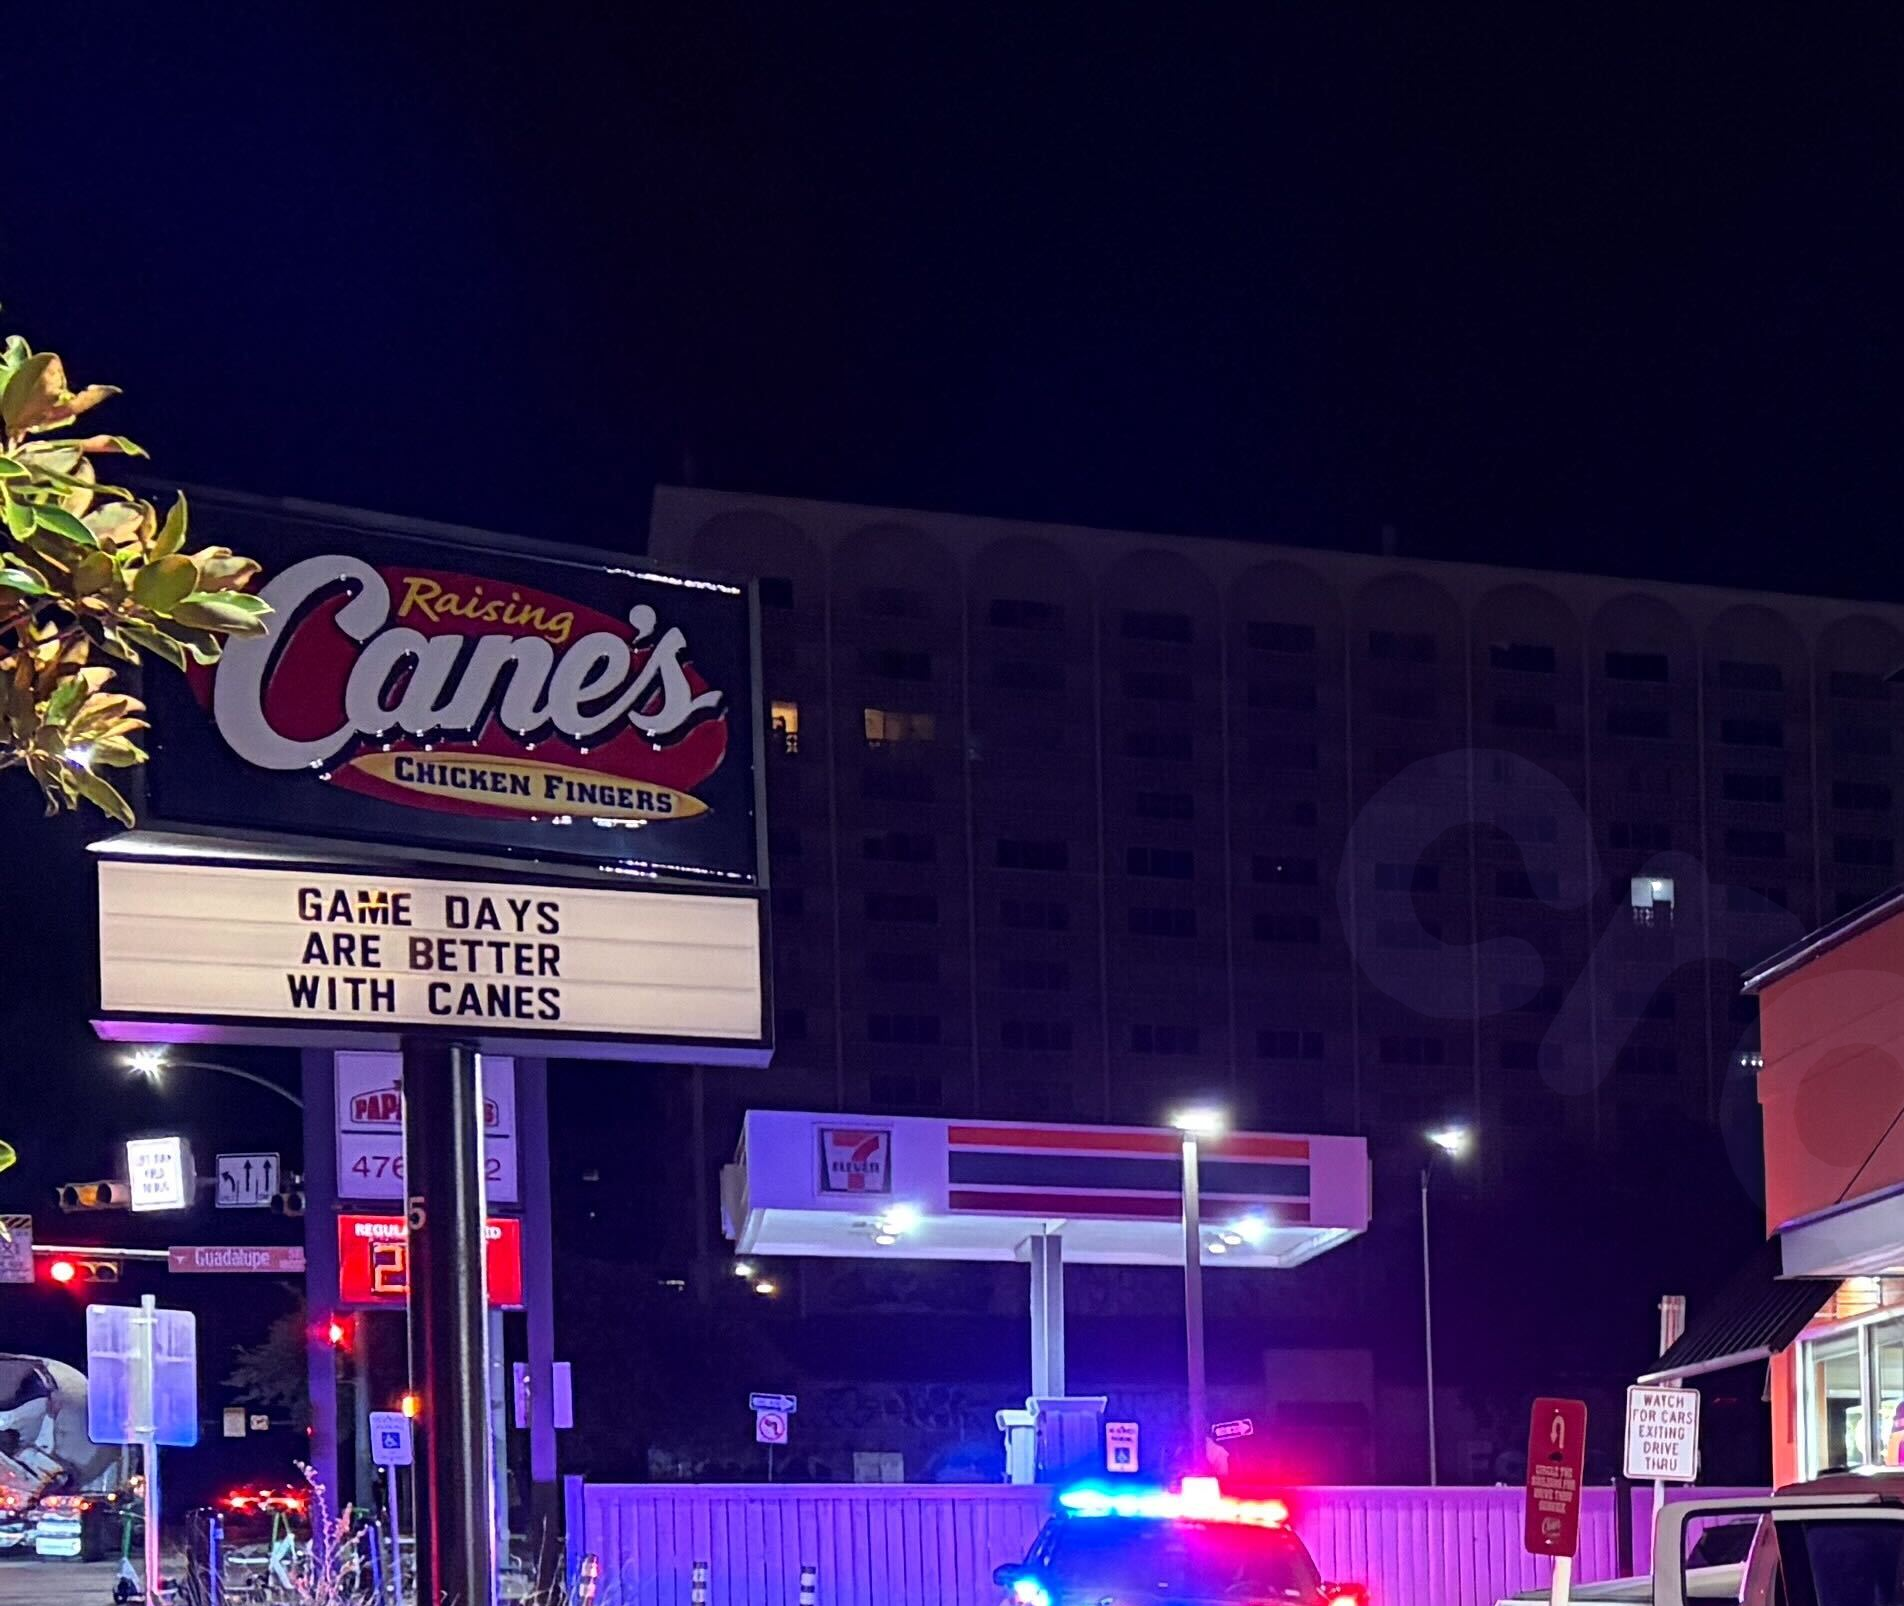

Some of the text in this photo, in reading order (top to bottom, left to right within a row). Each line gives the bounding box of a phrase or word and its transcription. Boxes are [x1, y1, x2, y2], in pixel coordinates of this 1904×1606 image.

[399, 577, 575, 643] Raising
[214, 555, 723, 770] Cane's
[393, 755, 673, 814] CHICKEN FINGERS
[298, 887, 562, 936] GAME DAYS
[302, 932, 562, 977] ARE BETTER
[287, 974, 562, 1021] WITH CANES
[195, 1248, 271, 1270] Guadalupe
[1632, 1409, 1693, 1425] FOR CARS
[1643, 1394, 1685, 1409] WATCH
[1639, 1425, 1685, 1440] EXITING
[1643, 1441, 1679, 1456] DRIVE
[1645, 1457, 1678, 1471] THRU
